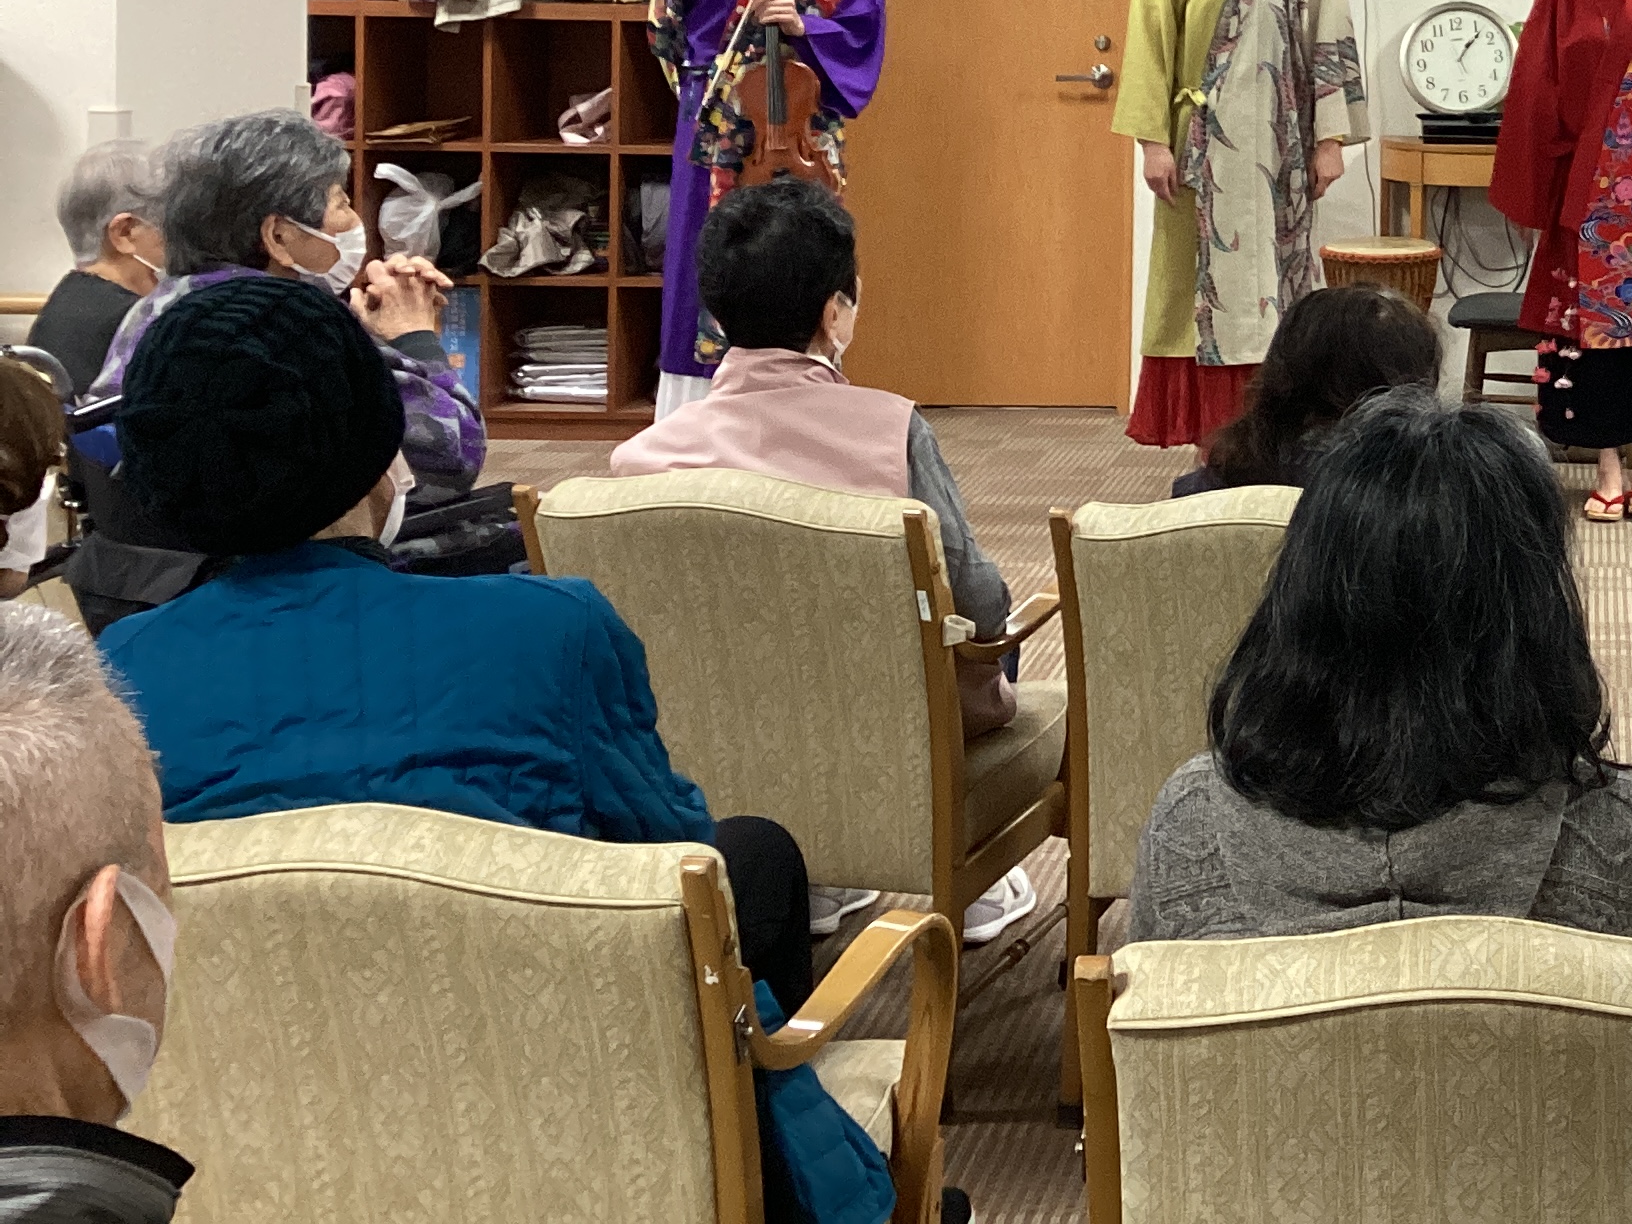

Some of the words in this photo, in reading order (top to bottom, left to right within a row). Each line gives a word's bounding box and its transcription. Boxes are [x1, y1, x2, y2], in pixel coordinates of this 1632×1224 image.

[1433, 24, 1443, 37] 11
[1449, 17, 1462, 31] 12
[1473, 20, 1479, 33] 1
[1486, 31, 1495, 45] 2
[1420, 39, 1434, 53] 10
[1494, 49, 1504, 63] 3
[1416, 58, 1427, 72] 9
[1425, 76, 1436, 90] 8
[1440, 88, 1449, 101] 7
[1458, 90, 1469, 104] 6
[1478, 84, 1487, 97] 5
